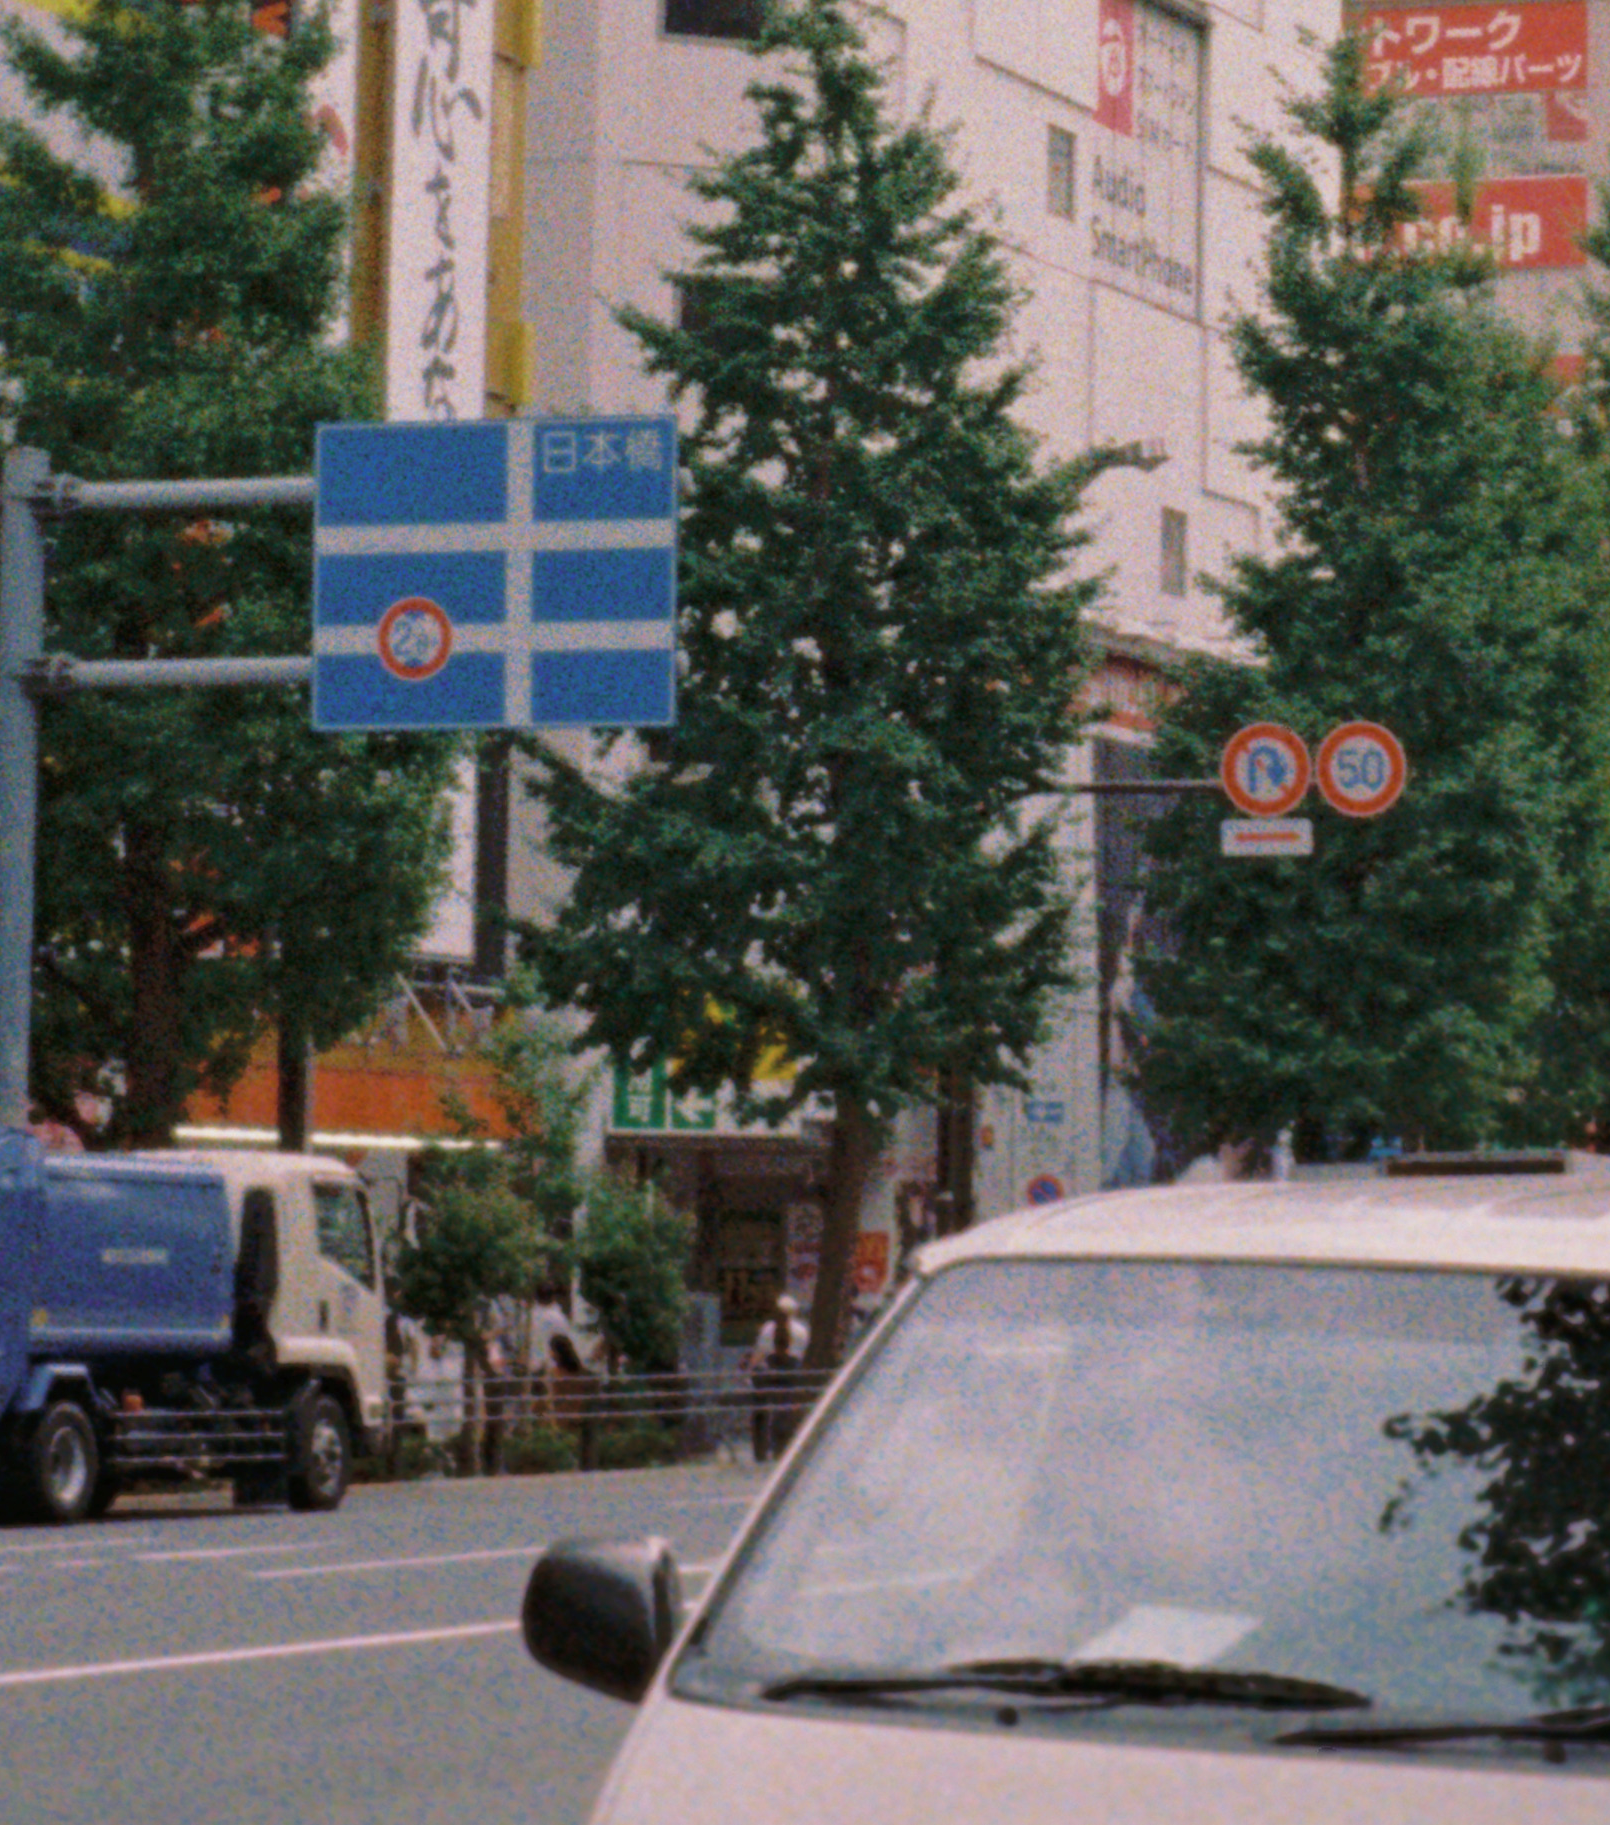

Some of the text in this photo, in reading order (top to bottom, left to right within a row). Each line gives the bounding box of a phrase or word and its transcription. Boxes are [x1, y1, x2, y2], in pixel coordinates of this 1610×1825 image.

[540, 429, 665, 477] 日本橋
[1336, 747, 1385, 791] 50
